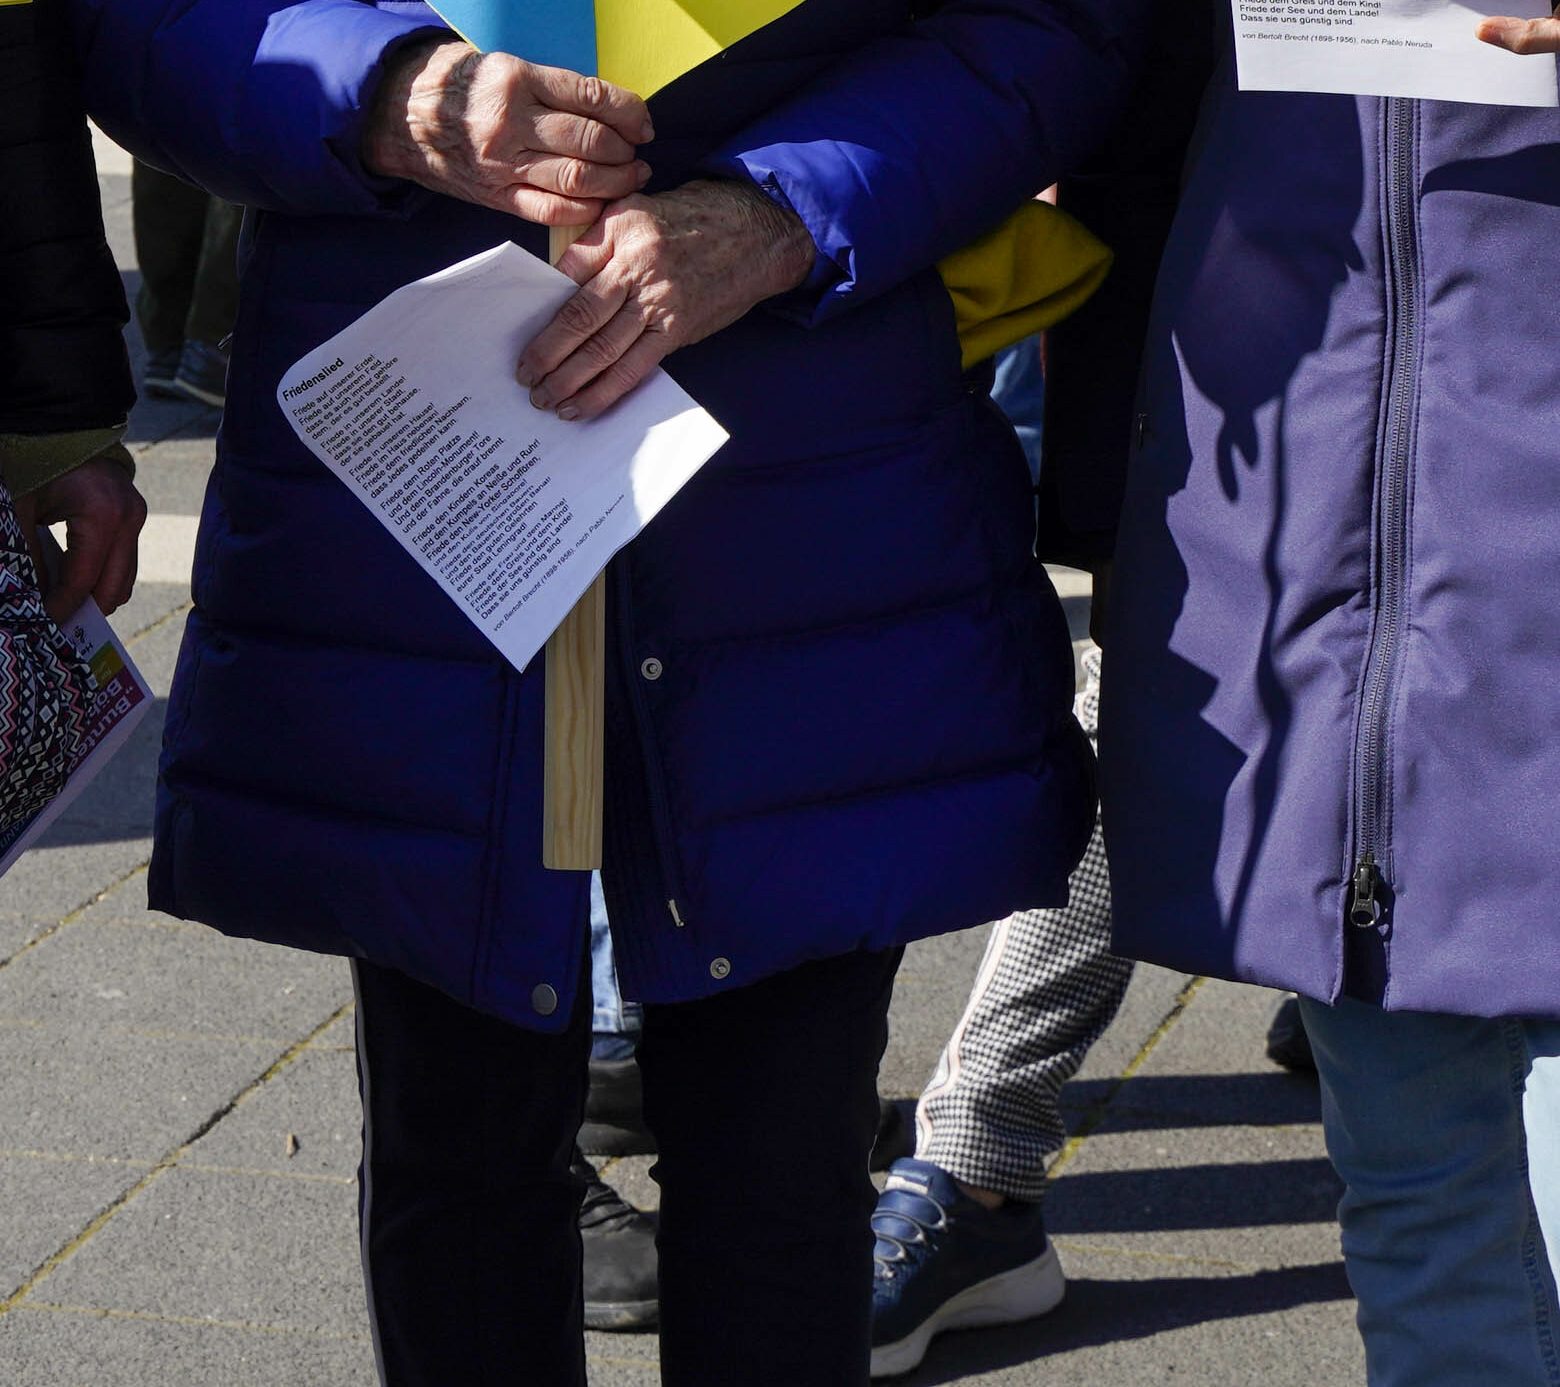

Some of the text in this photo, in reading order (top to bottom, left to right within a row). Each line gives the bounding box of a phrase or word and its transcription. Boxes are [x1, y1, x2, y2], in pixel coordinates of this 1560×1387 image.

[1240, 4, 1268, 12] Friede
[1241, 14, 1263, 22] Dass
[1299, 17, 1332, 25] günstig
[282, 358, 344, 400] Friedenslied
